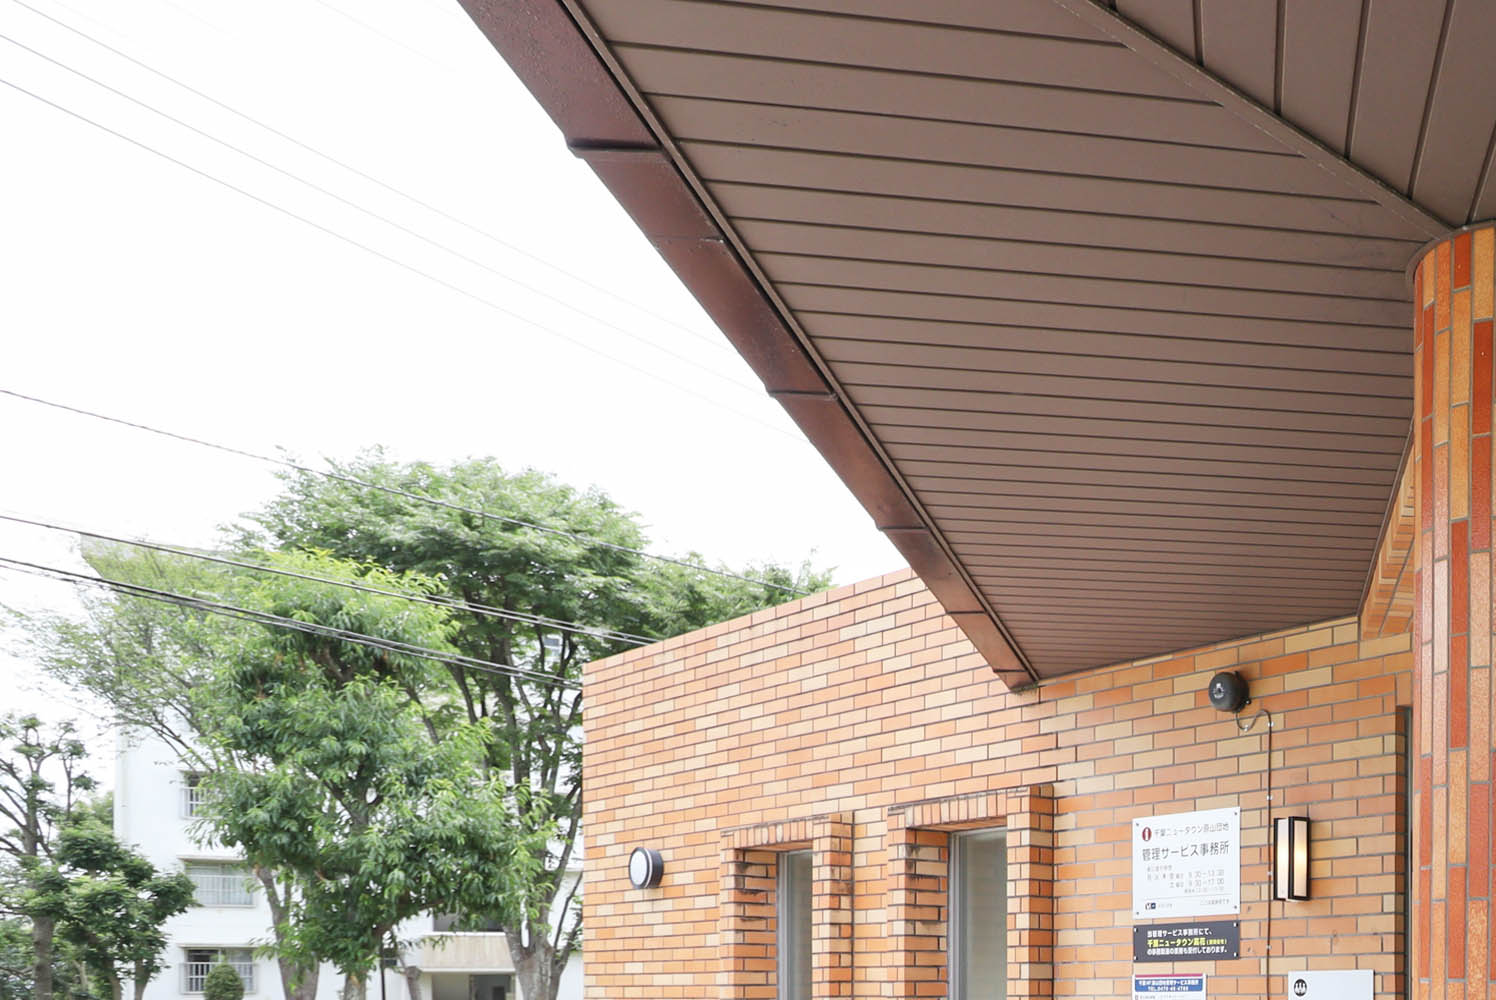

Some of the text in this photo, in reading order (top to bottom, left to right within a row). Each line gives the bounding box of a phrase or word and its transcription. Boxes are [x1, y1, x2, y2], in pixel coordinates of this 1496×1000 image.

[1142, 841, 1229, 861] 管理サービス事務所
